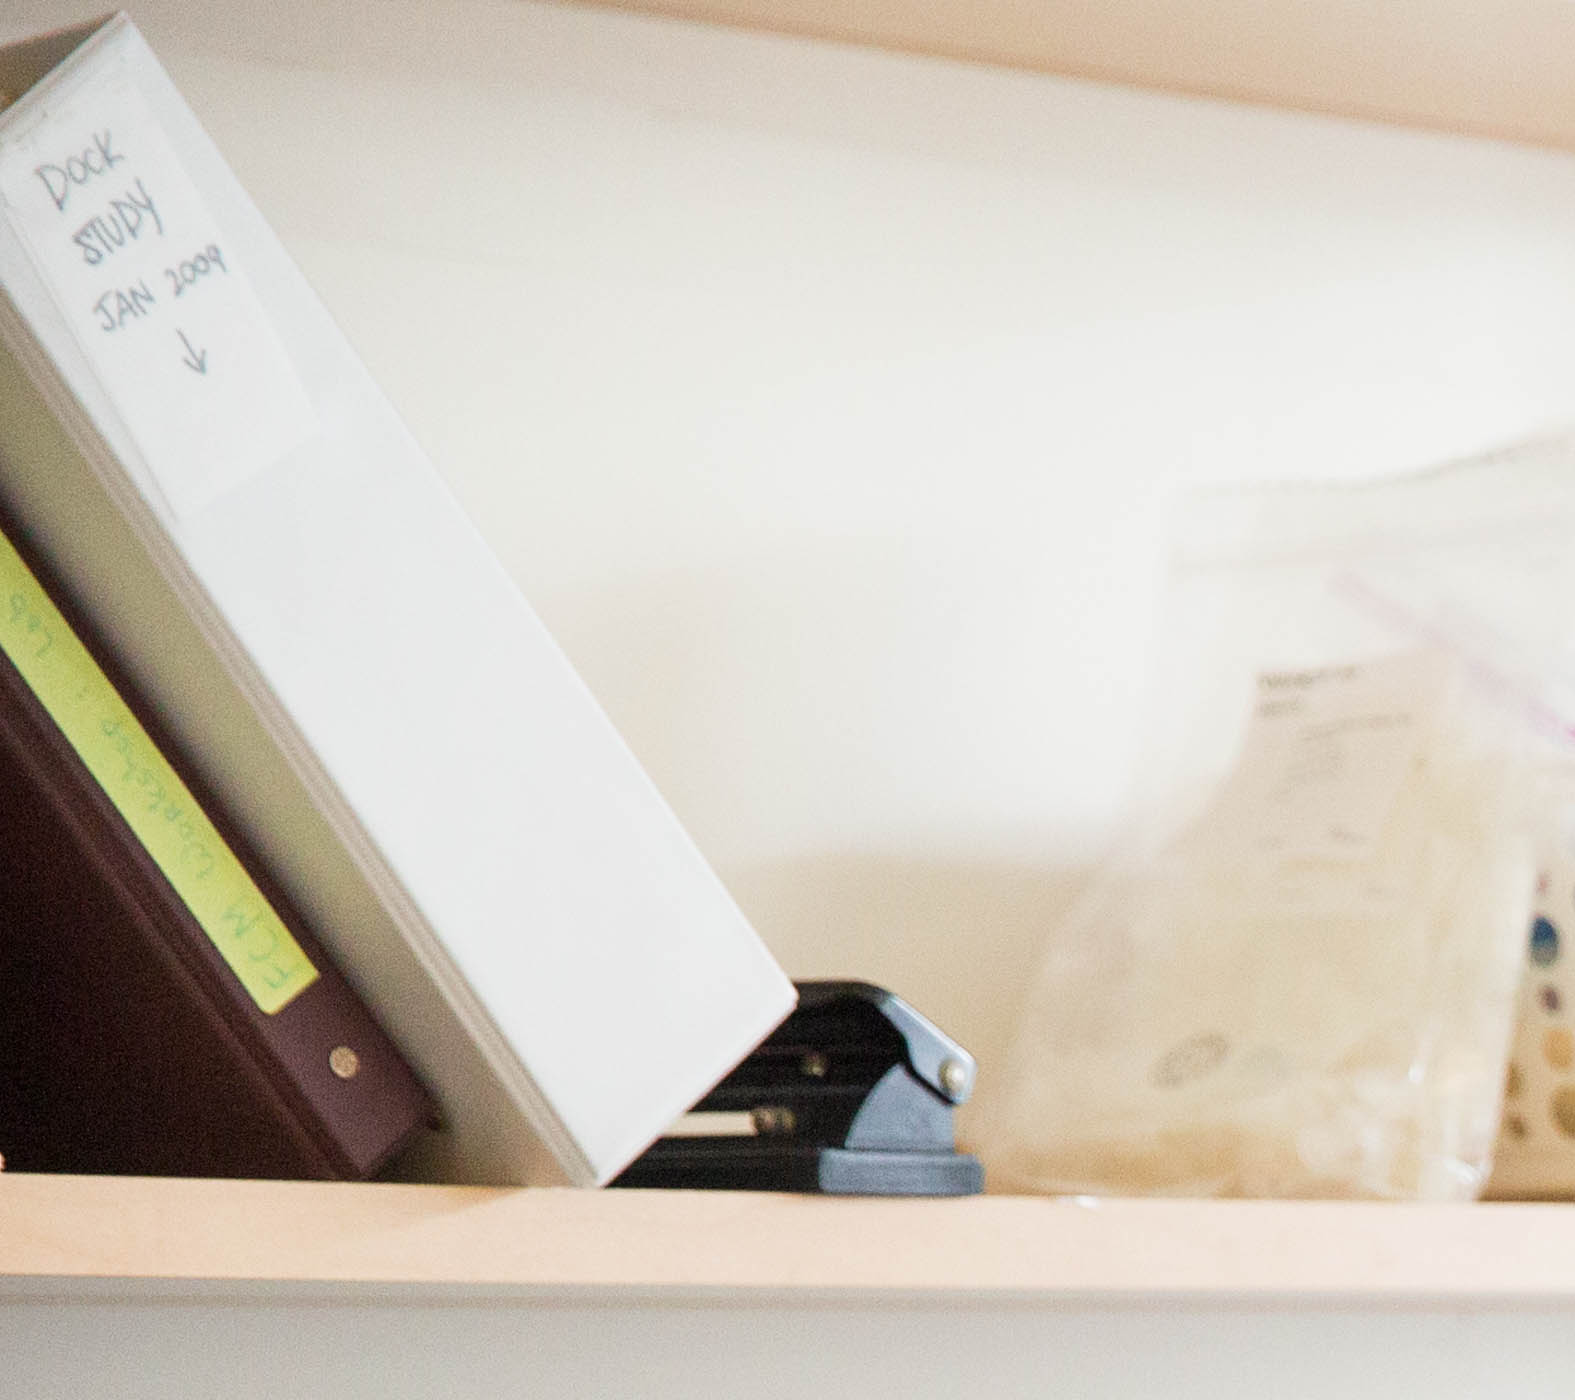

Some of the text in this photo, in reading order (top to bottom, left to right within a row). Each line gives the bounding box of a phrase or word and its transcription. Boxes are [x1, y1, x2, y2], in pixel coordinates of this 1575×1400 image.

[71, 176, 164, 266] STUDY
[92, 243, 228, 333] JAN 2009
